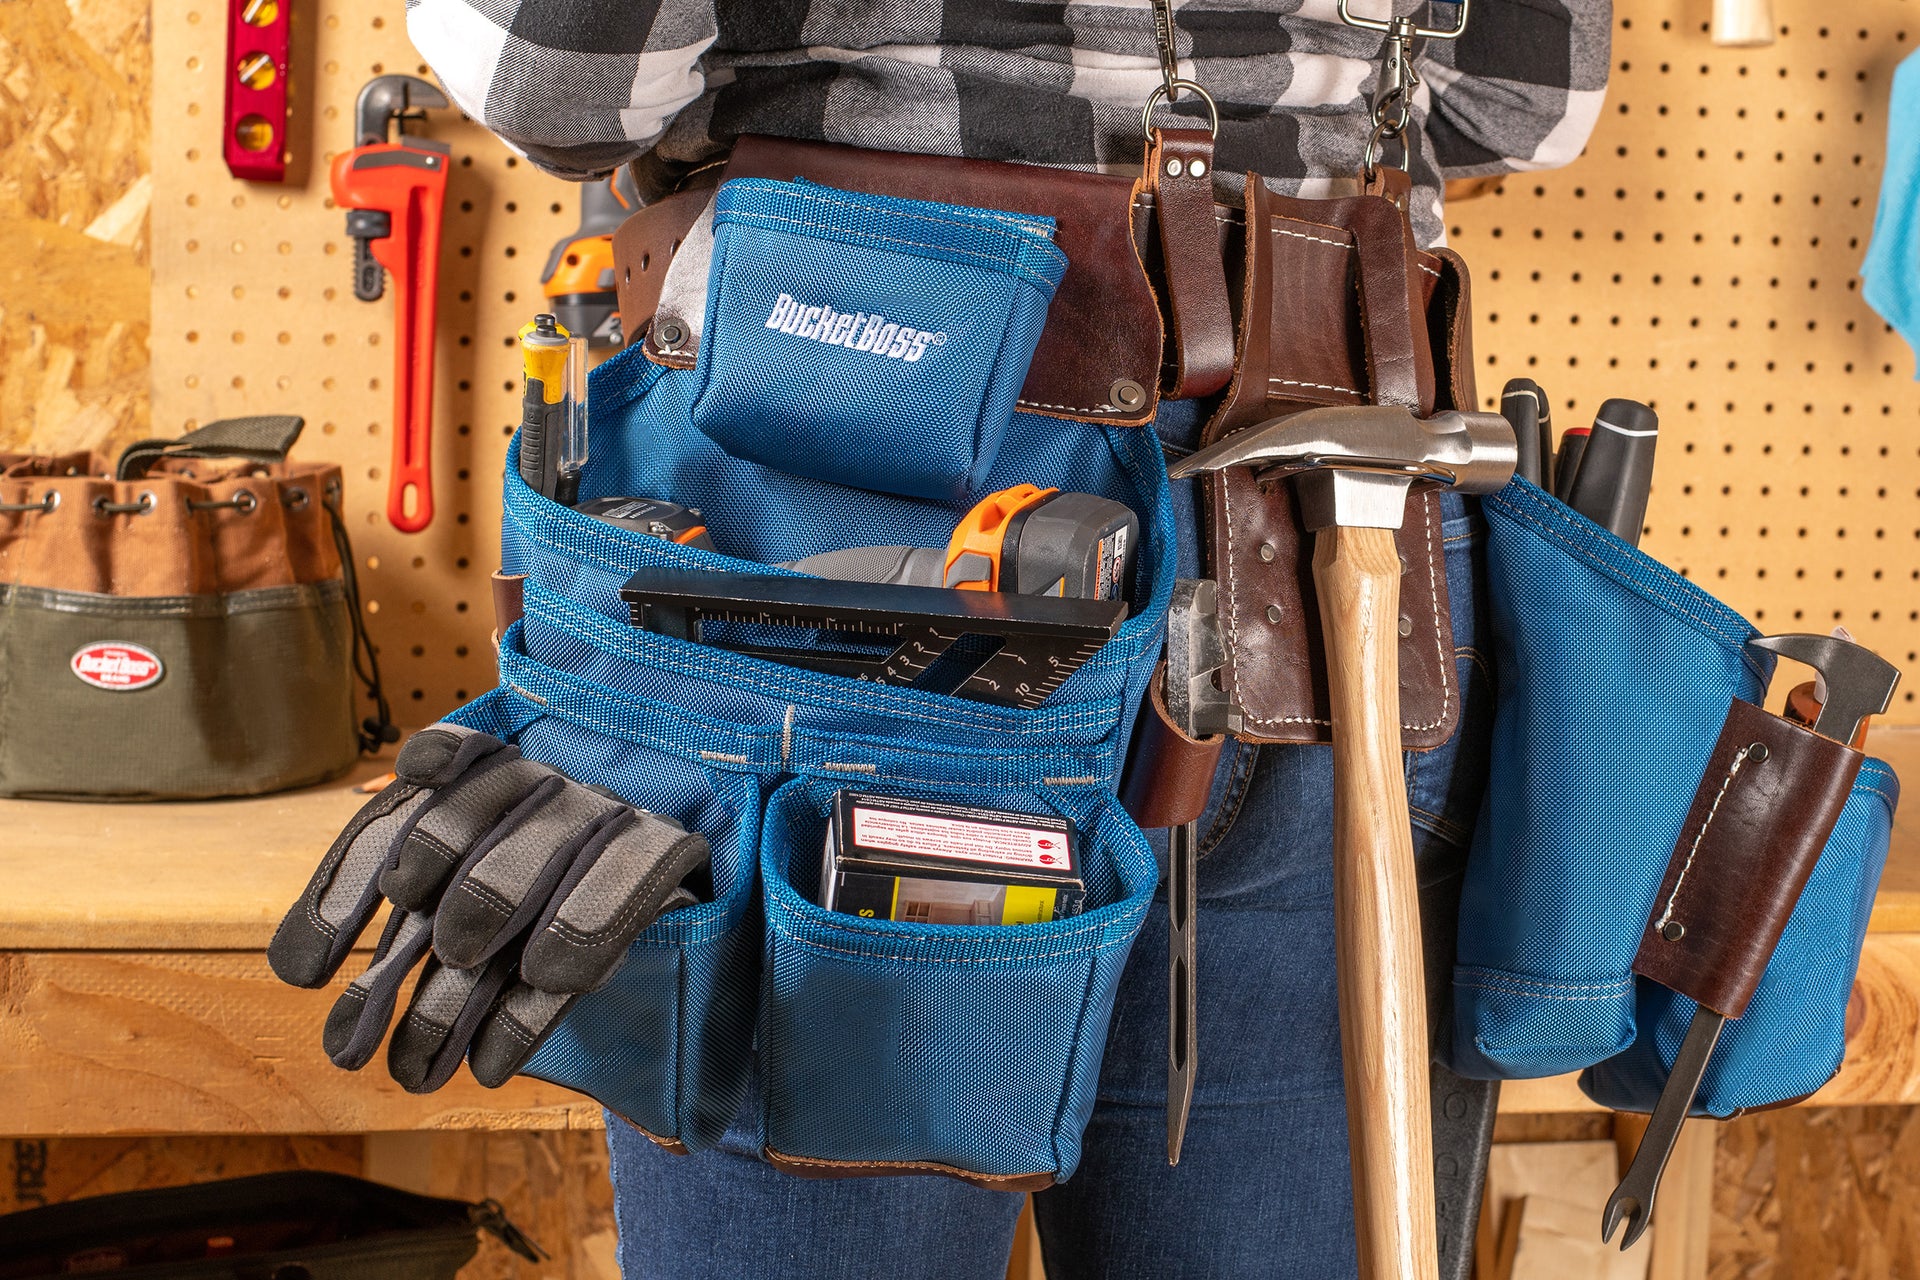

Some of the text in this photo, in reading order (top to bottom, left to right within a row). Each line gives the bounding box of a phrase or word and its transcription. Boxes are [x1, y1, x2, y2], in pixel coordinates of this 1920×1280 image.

[929, 626, 940, 637] 1
[913, 641, 925, 652] 2
[900, 654, 911, 666] 3
[1016, 656, 1028, 666] 1
[1048, 655, 1060, 667] 5
[886, 666, 897, 676] 4
[988, 680, 1001, 691] 2
[1014, 682, 1032, 697] 10
